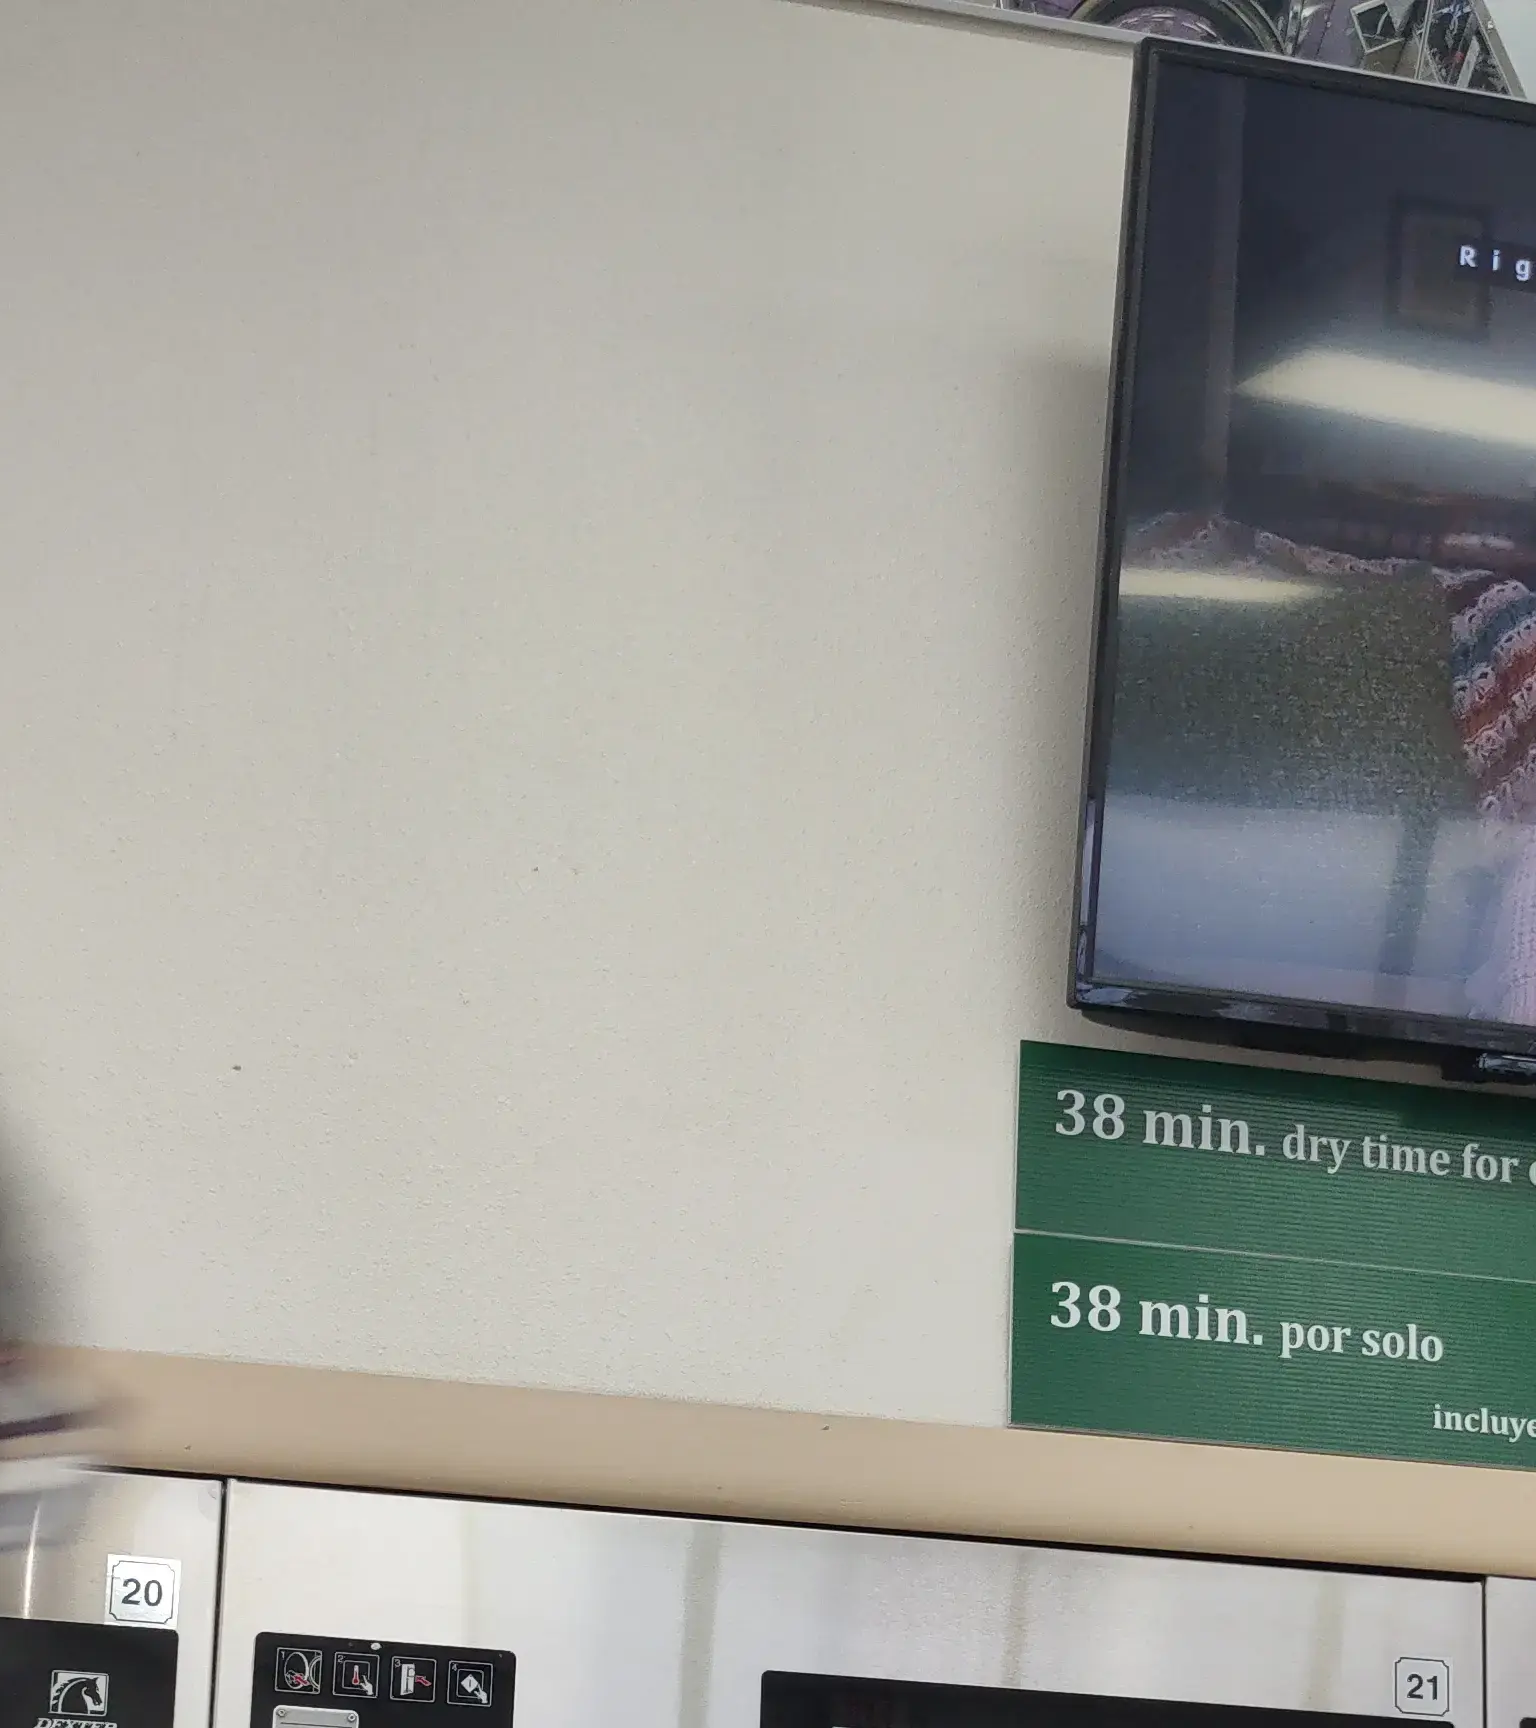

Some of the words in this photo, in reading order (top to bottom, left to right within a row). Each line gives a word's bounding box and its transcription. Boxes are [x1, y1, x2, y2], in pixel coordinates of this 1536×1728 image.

[1055, 1089, 1125, 1141] 38
[1142, 1104, 1265, 1156] min.
[1282, 1124, 1350, 1175] dry
[1361, 1134, 1451, 1176] time
[1461, 1143, 1519, 1183] for
[1050, 1281, 1122, 1332] 38
[1138, 1294, 1263, 1346] min.
[1278, 1320, 1352, 1359] por
[1361, 1323, 1444, 1363] solo
[120, 1577, 163, 1607] 20
[1406, 1673, 1438, 1701] 21
